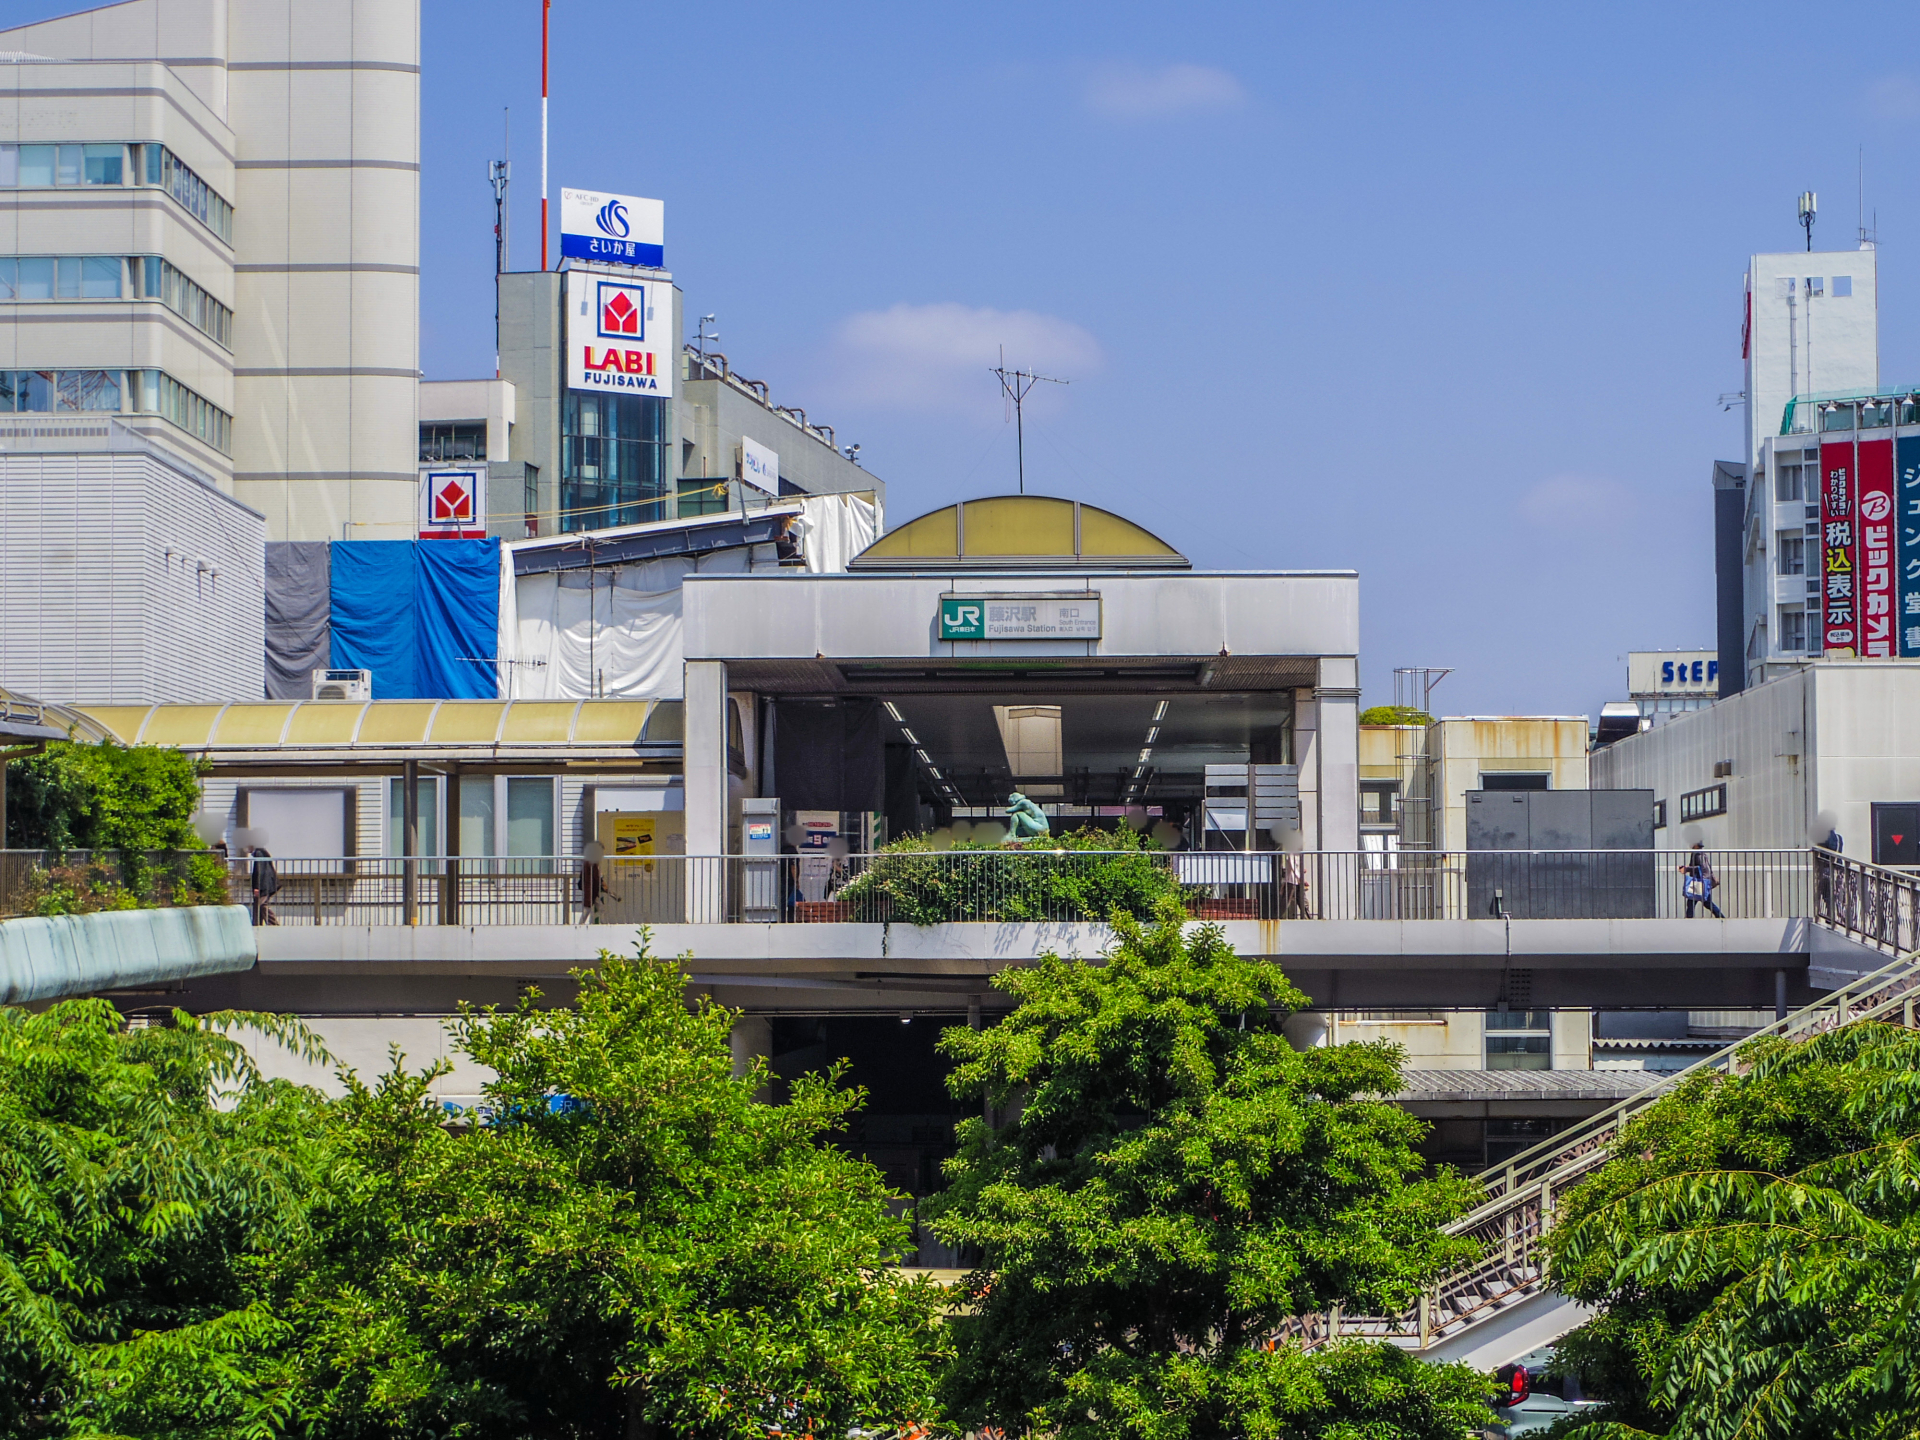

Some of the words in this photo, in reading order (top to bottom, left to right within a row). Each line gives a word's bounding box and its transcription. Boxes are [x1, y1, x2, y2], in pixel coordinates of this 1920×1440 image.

[589, 238, 636, 257] さいか屋
[584, 345, 657, 376] LABI
[584, 372, 657, 390] FUJISAWA
[1825, 521, 1853, 624] 税込表示
[945, 606, 980, 626] JR
[988, 606, 1037, 622] 藤沢駅
[1059, 608, 1080, 618] 南口
[988, 624, 1025, 634] Fujisawa
[1026, 624, 1056, 633] Station
